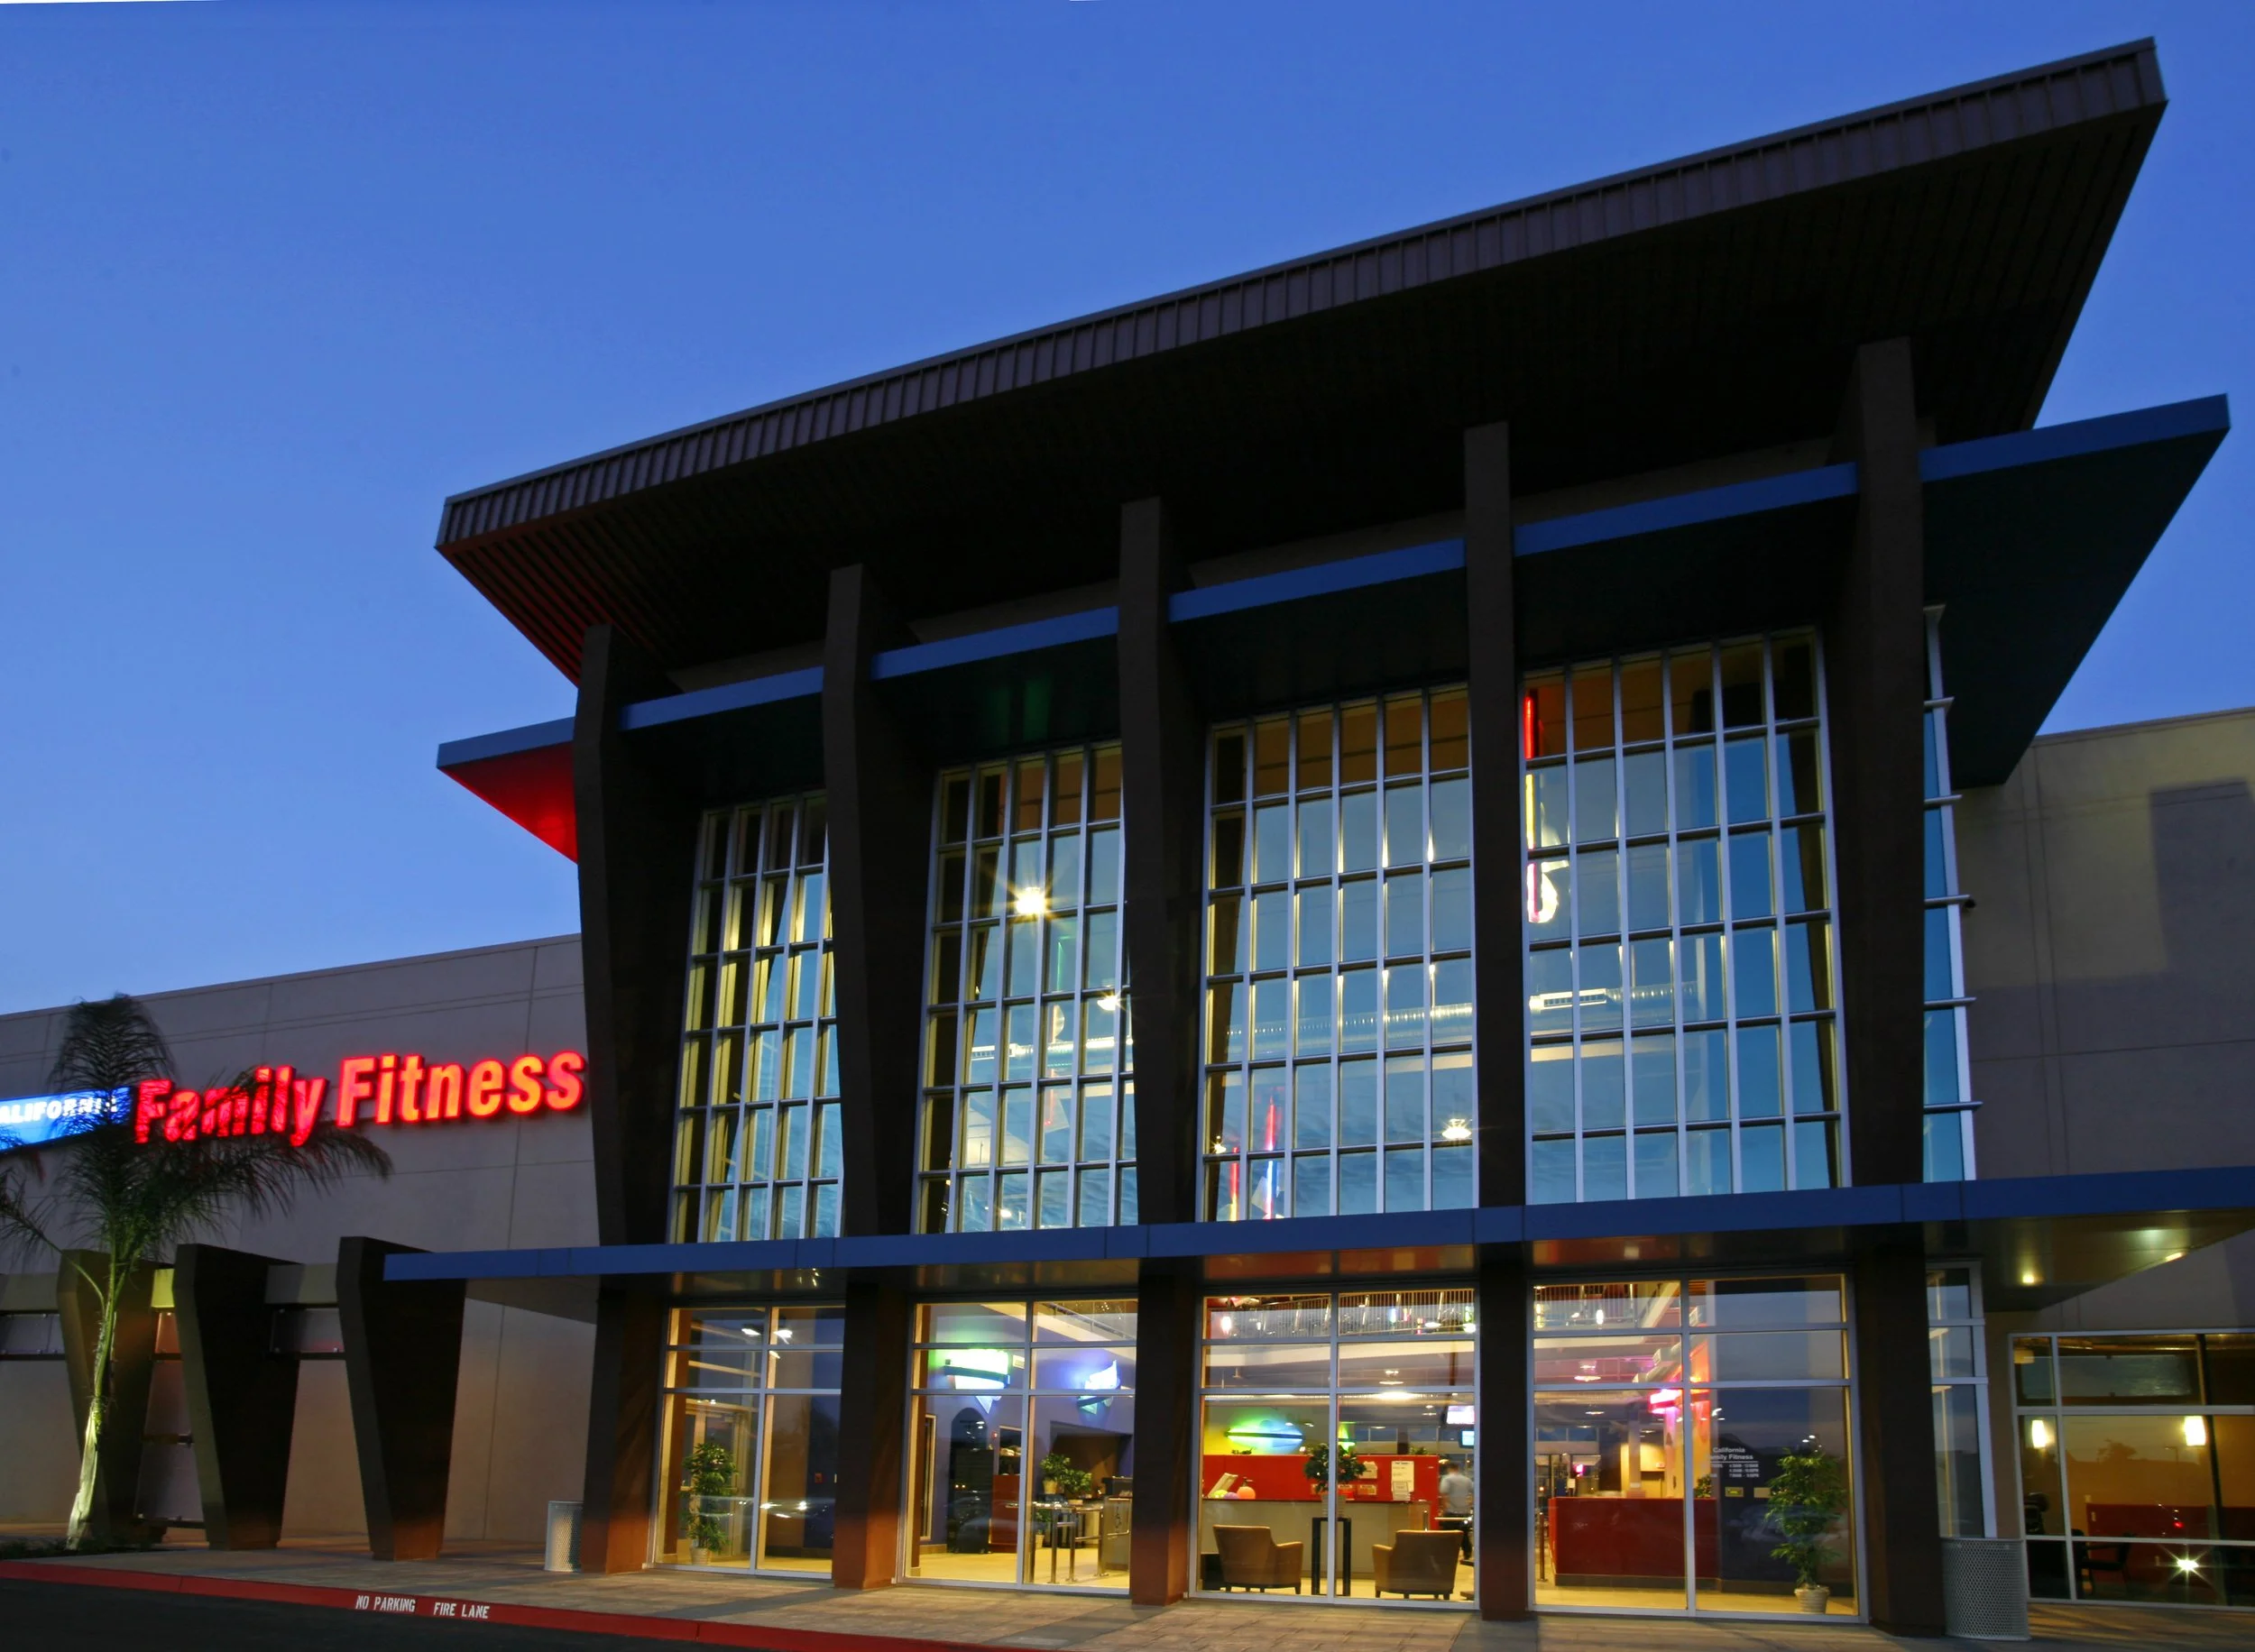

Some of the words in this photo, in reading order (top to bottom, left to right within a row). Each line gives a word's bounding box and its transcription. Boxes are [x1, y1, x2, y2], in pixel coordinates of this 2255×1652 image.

[134, 1065, 327, 1147] Family
[335, 1050, 586, 1128] Fitness
[355, 1594, 370, 1611] NO
[373, 1596, 417, 1613] PARKING
[433, 1602, 457, 1617] FIRE
[461, 1604, 491, 1620] LANE
